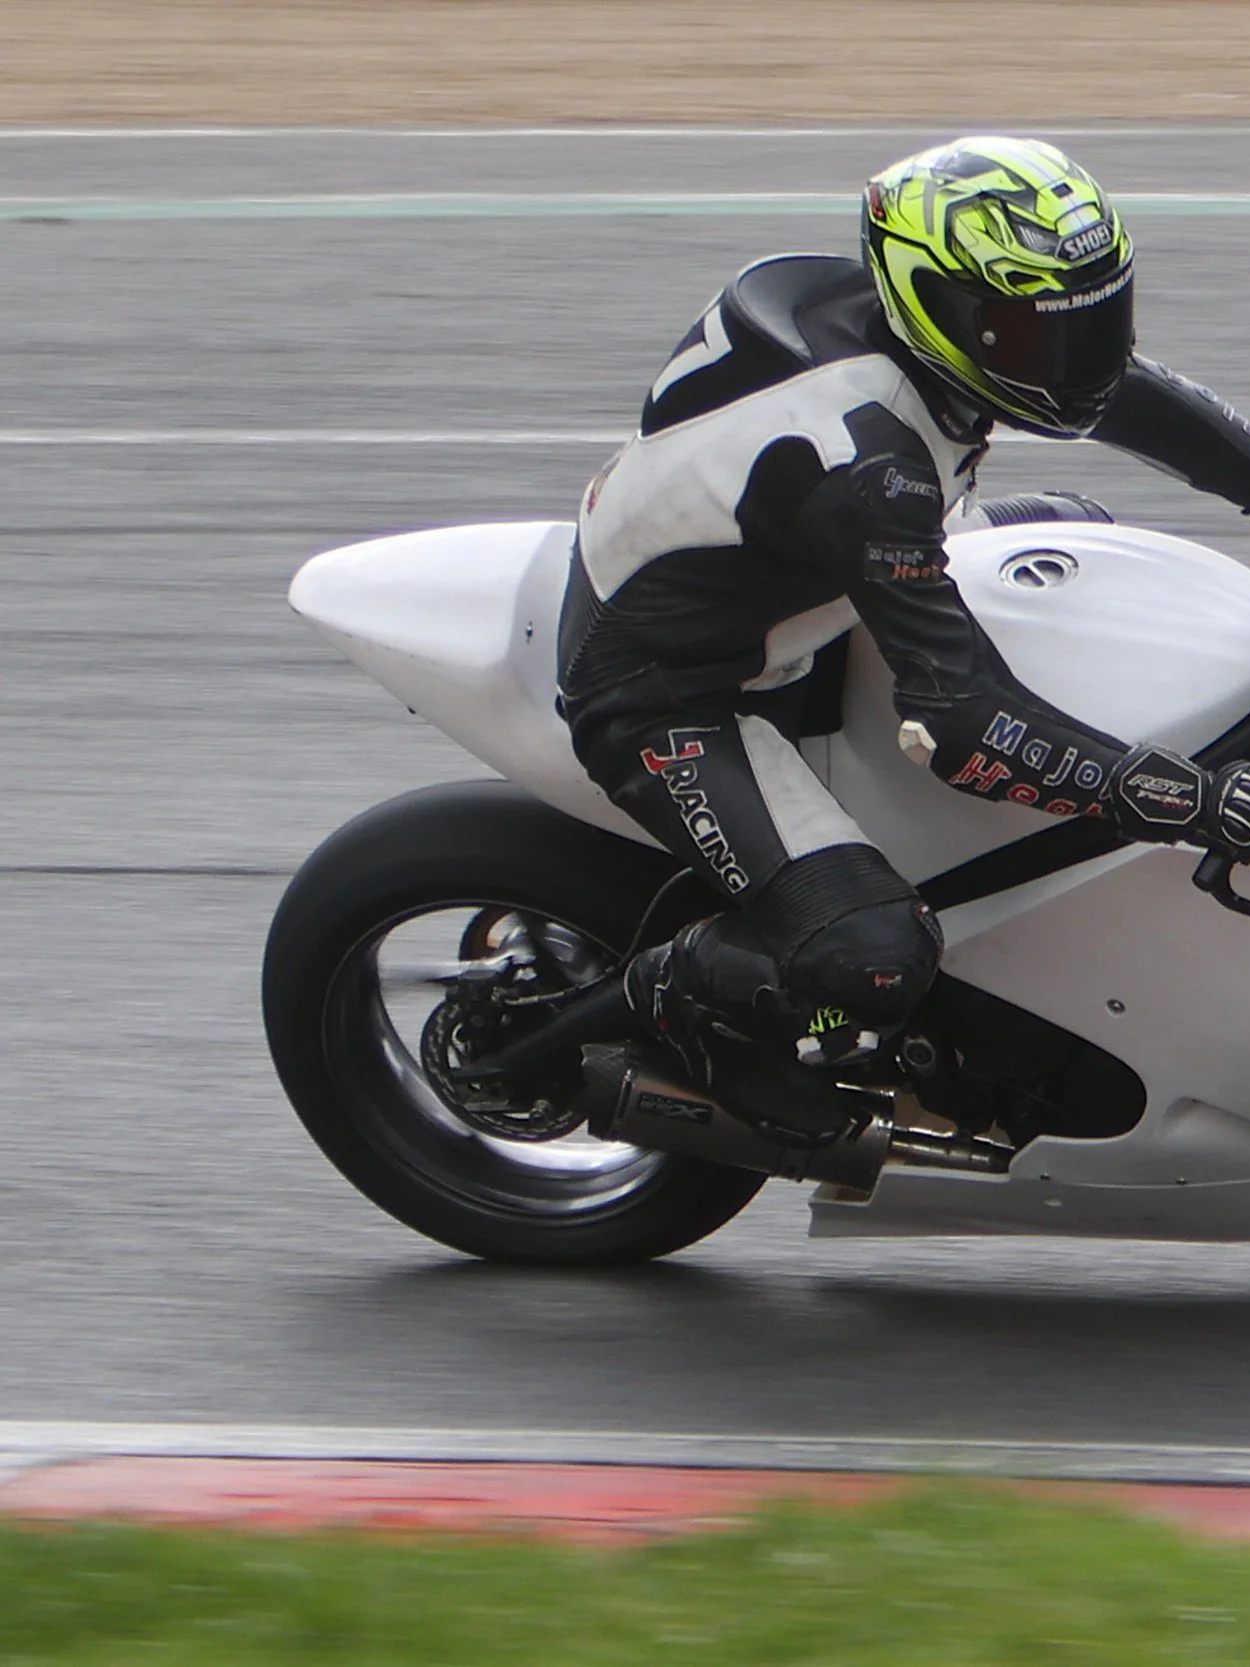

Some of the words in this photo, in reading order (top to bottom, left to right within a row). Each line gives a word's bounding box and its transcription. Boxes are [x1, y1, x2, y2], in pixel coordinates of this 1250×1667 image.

[1063, 223, 1111, 260] SHOEI
[981, 710, 1116, 799] Majo
[1127, 773, 1195, 796] RST
[662, 762, 750, 895] RACING
